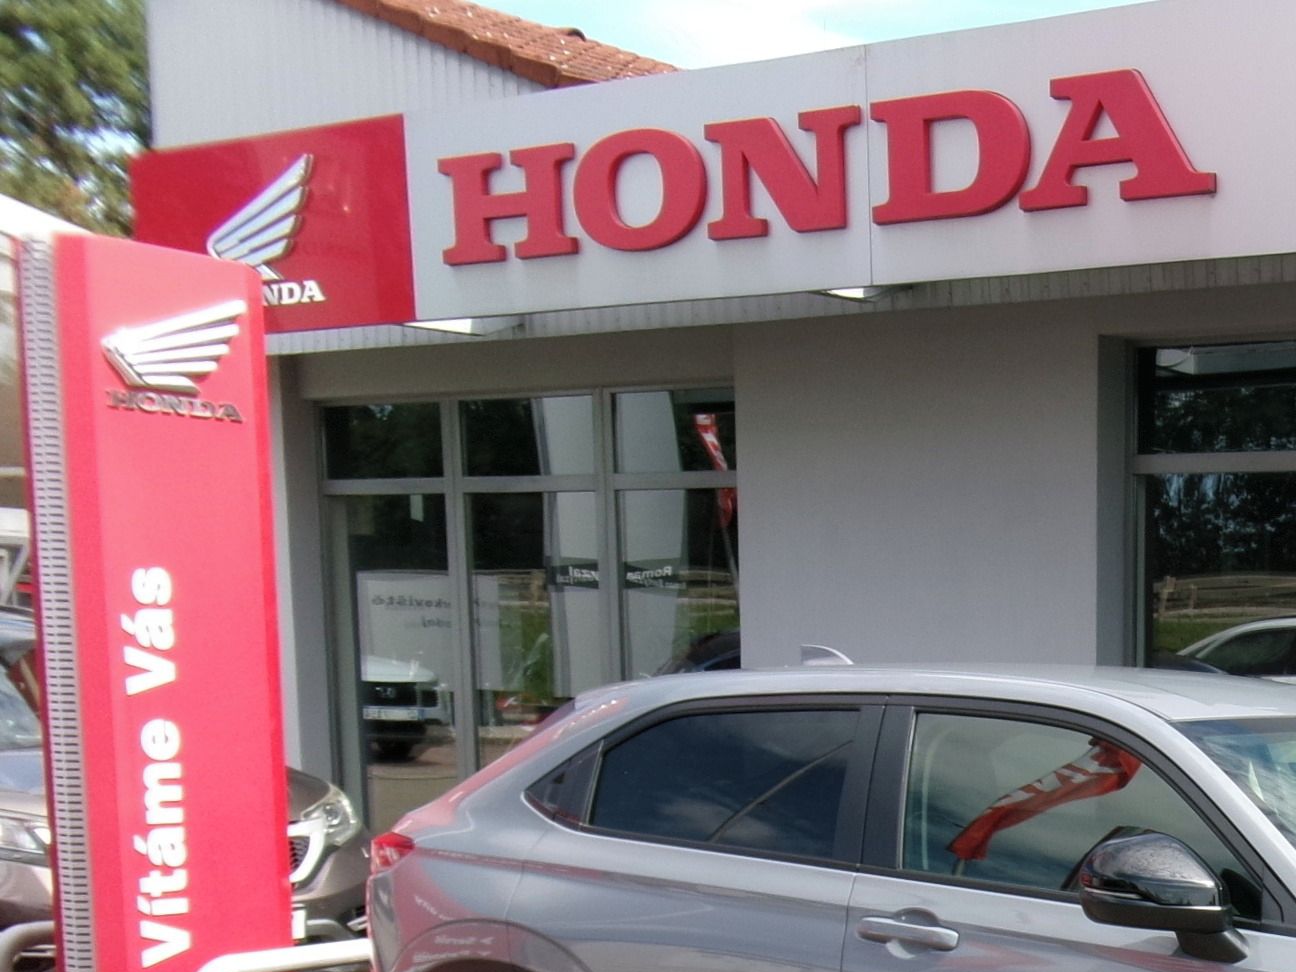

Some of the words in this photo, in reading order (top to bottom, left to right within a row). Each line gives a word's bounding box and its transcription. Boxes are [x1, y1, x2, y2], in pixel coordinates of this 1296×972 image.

[437, 67, 1217, 266] HONDA
[262, 279, 327, 306] NDA
[105, 389, 243, 424] HONDA
[120, 566, 177, 697] Vás
[133, 718, 192, 968] Vítáme
